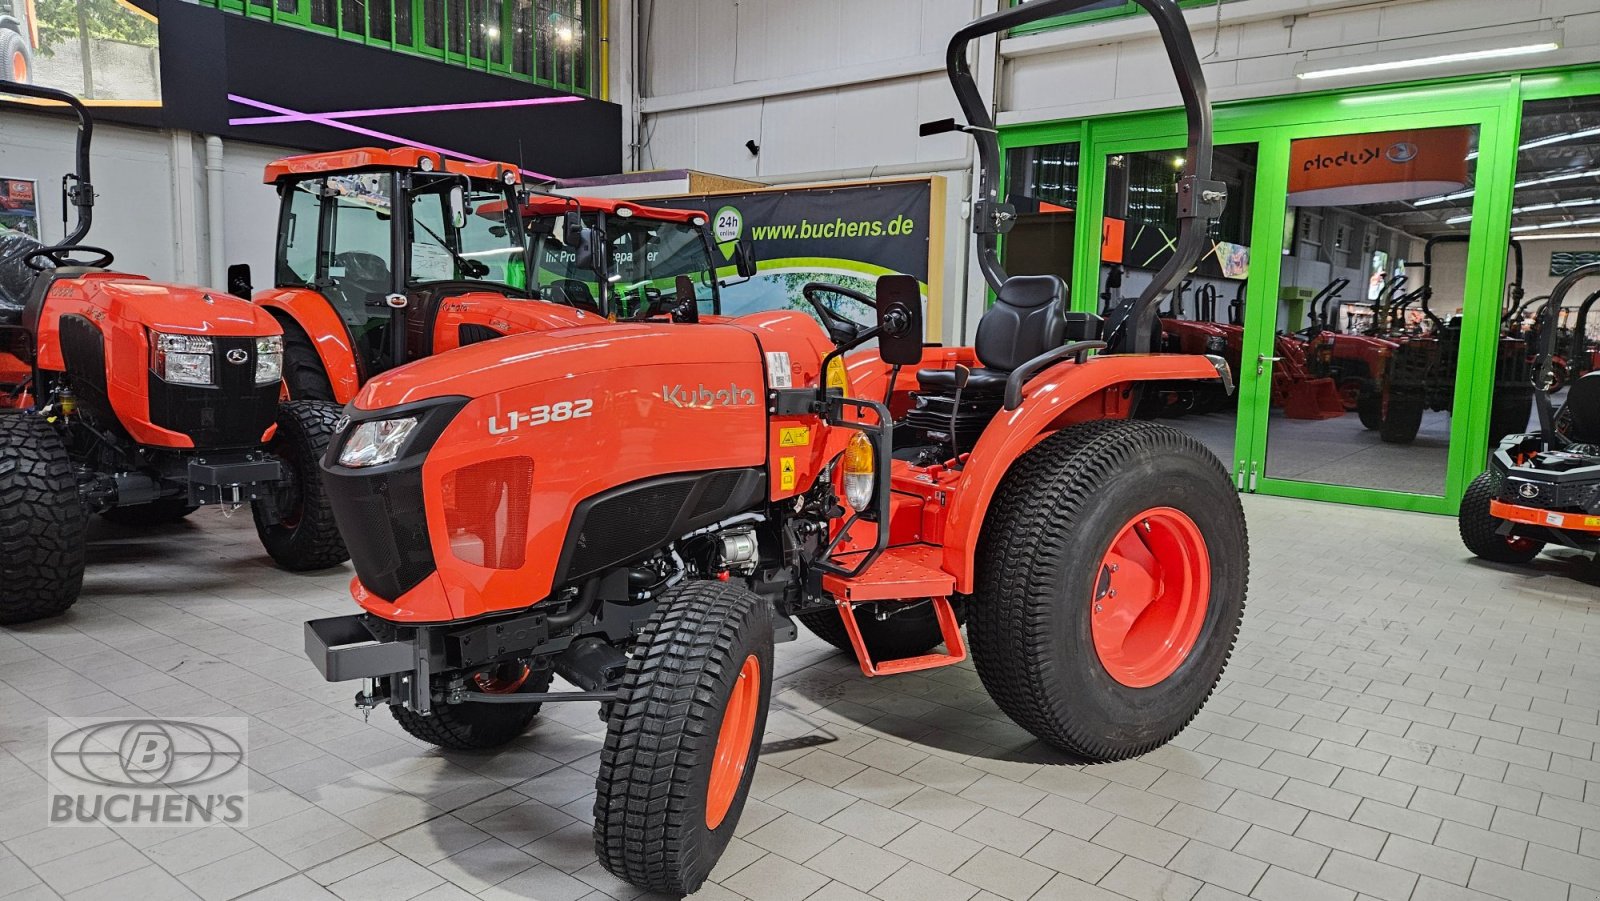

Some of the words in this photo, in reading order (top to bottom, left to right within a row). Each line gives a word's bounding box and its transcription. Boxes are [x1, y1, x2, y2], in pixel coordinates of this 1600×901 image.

[718, 216, 738, 228] 24h
[751, 214, 914, 241] www.buchens.de
[662, 382, 756, 408] Kubota
[488, 398, 594, 435] L1-382
